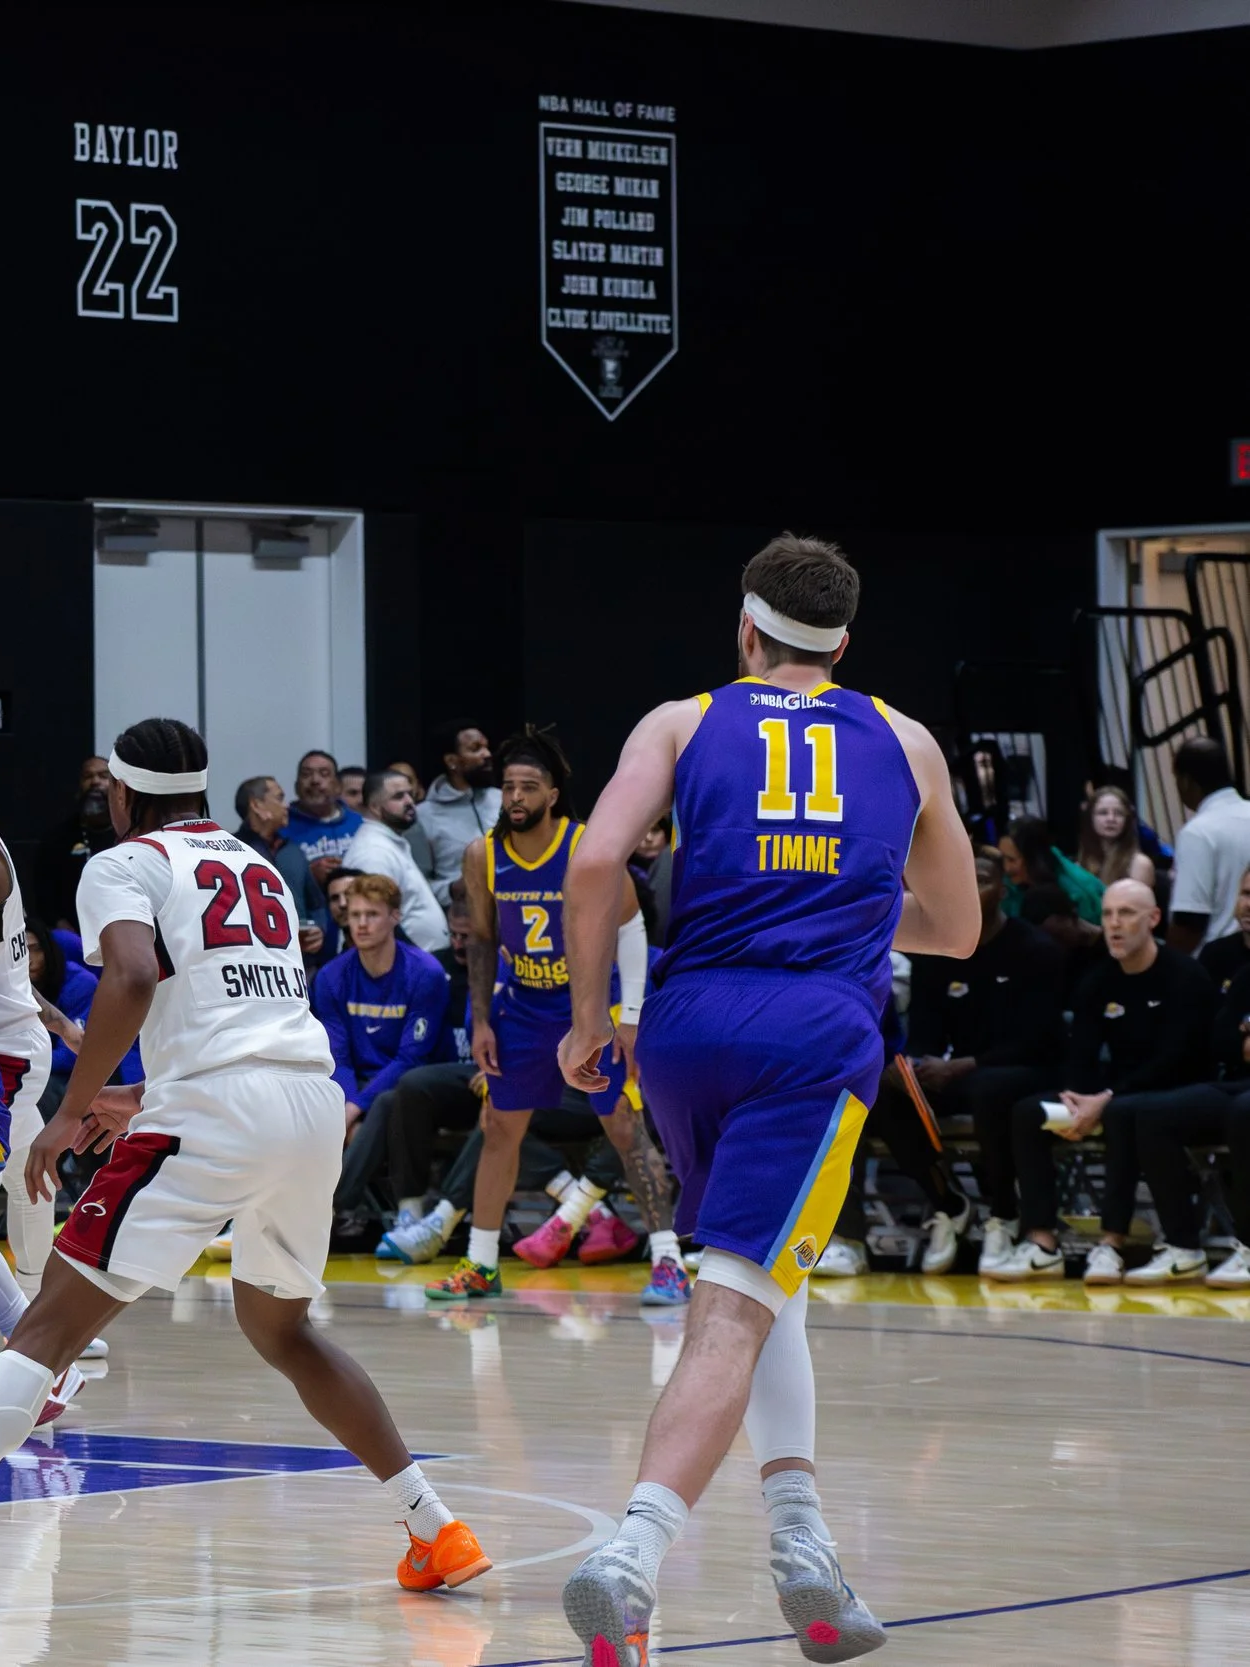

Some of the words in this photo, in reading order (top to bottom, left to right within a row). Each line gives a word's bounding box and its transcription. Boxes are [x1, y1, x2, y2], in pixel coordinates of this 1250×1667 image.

[538, 94, 570, 113] NBA
[572, 97, 610, 117] HALL
[612, 101, 634, 118] OF
[636, 103, 676, 123] FAME
[74, 122, 178, 170] BAYLOR
[554, 171, 610, 195] GEORGE
[613, 175, 660, 199] MIKAN
[560, 205, 590, 228] JIM
[593, 208, 655, 232] POLLARD
[76, 198, 179, 323] 22
[551, 238, 606, 263] SLATER
[609, 243, 664, 267] MARTIN
[560, 273, 598, 296] JOHN
[547, 306, 589, 330] CLYDE
[760, 693, 783, 709] NBA
[757, 717, 844, 822] 11
[755, 834, 842, 875] TIMME
[194, 859, 292, 950] 26
[494, 891, 543, 902] SOUTH
[542, 891, 564, 901] BA
[520, 904, 554, 953] 2
[221, 963, 291, 998] SMITH
[513, 953, 570, 986] bibig
